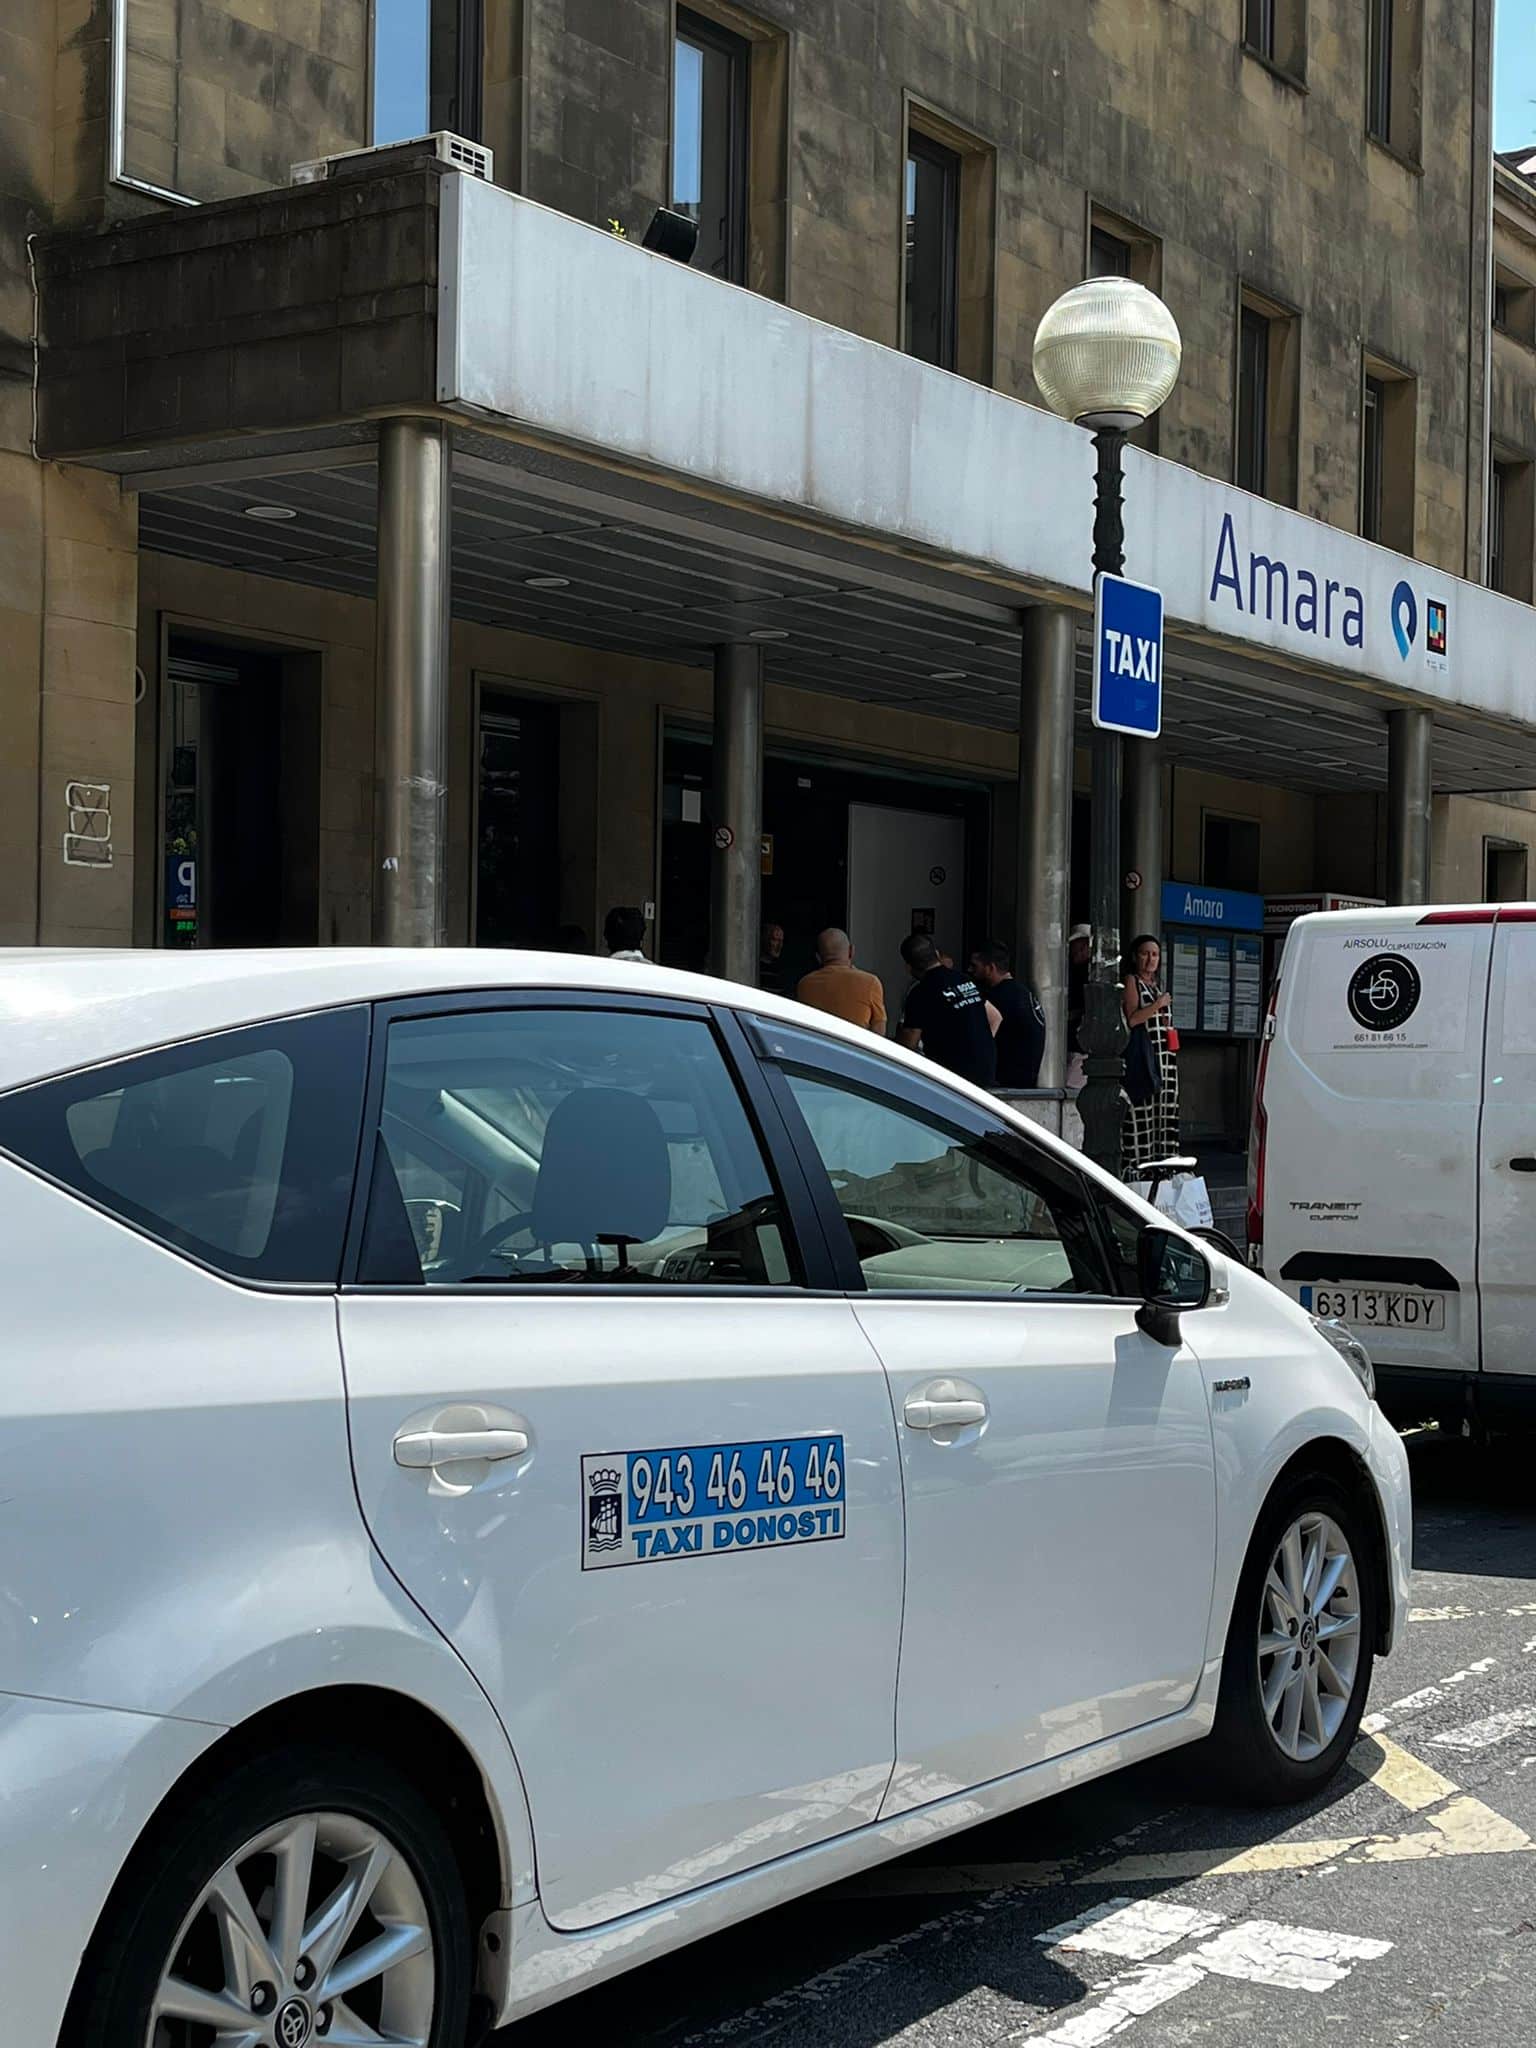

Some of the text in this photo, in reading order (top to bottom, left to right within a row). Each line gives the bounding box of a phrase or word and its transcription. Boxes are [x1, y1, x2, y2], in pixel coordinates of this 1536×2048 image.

[1209, 512, 1364, 649] Amara
[1105, 629, 1157, 684] TAXI
[1183, 890, 1224, 920] Amara
[1343, 938, 1389, 950] AIRSOLU
[1288, 1201, 1362, 1211] TRANSIT
[1316, 1292, 1435, 1325] 6313 KDY
[630, 1442, 842, 1519] 943 46 46 46
[631, 1507, 841, 1559] TAXI DONOSTI
